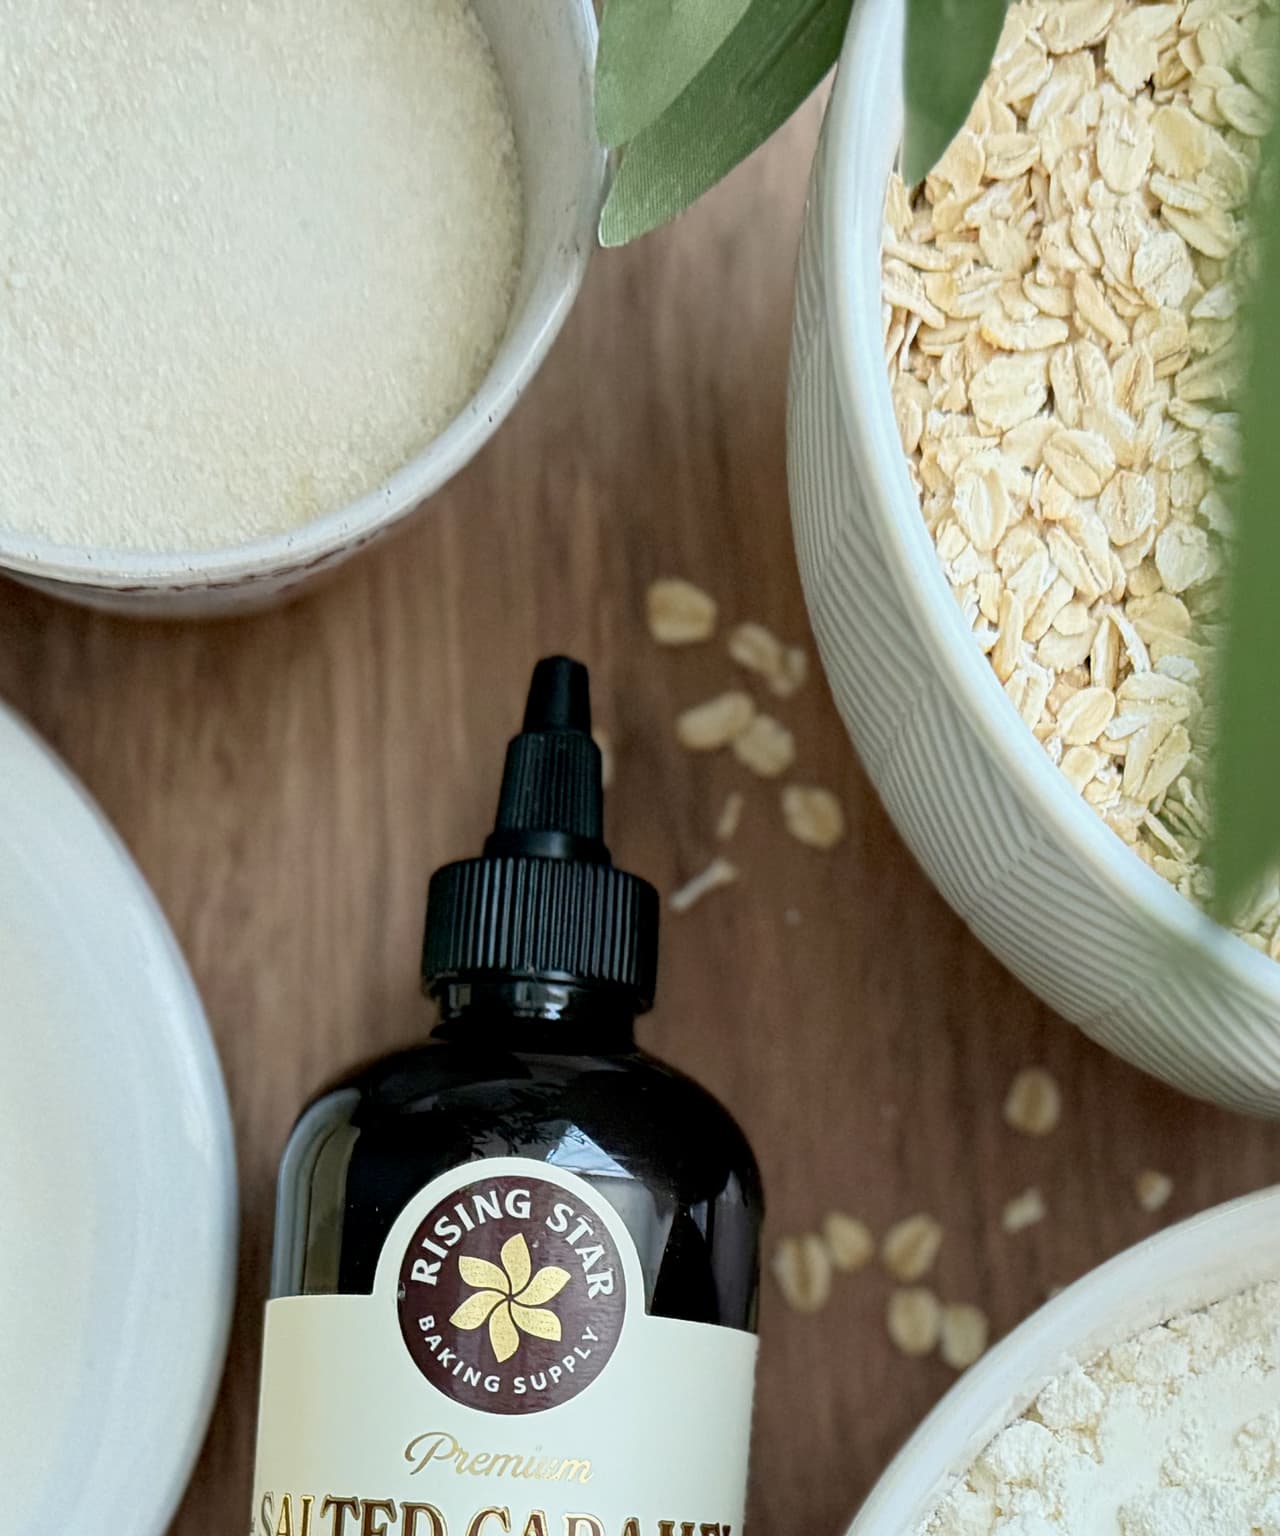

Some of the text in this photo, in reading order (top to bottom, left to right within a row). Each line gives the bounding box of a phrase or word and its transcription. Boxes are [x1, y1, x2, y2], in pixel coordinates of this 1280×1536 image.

[410, 1189, 615, 1299] RISING STAR
[418, 1314, 600, 1394] BAKING SUPPLY
[404, 1431, 594, 1483] Premium
